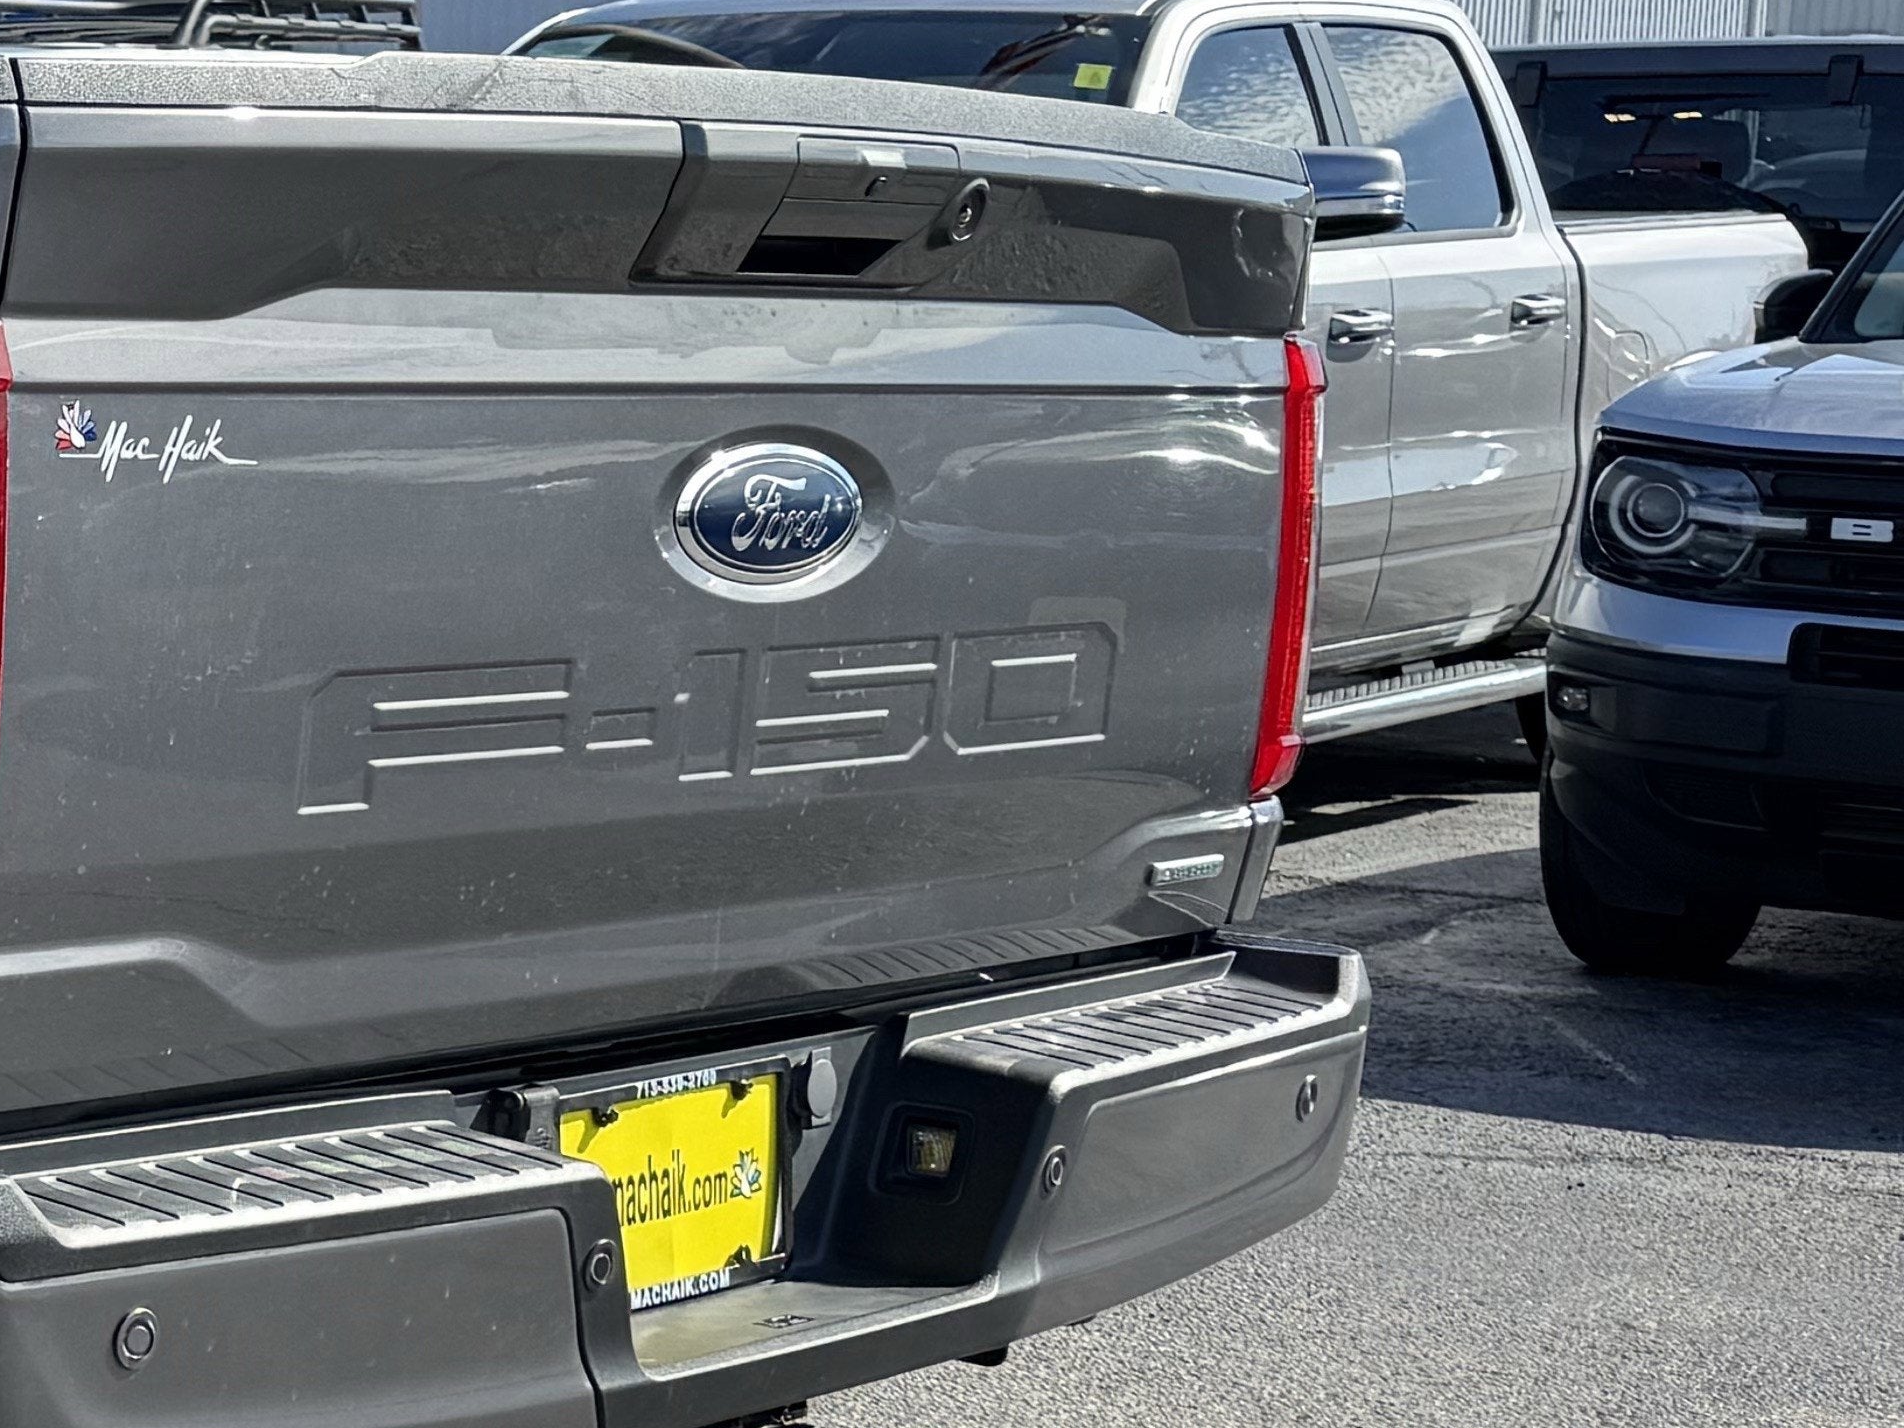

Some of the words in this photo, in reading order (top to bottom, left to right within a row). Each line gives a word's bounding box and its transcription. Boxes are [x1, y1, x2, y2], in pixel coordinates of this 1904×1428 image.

[74, 420, 159, 483] Mac
[158, 414, 254, 484] Haik
[731, 473, 832, 552] Ford
[298, 622, 1117, 816] F-150
[630, 1268, 731, 1310] MACHAIK.COM
